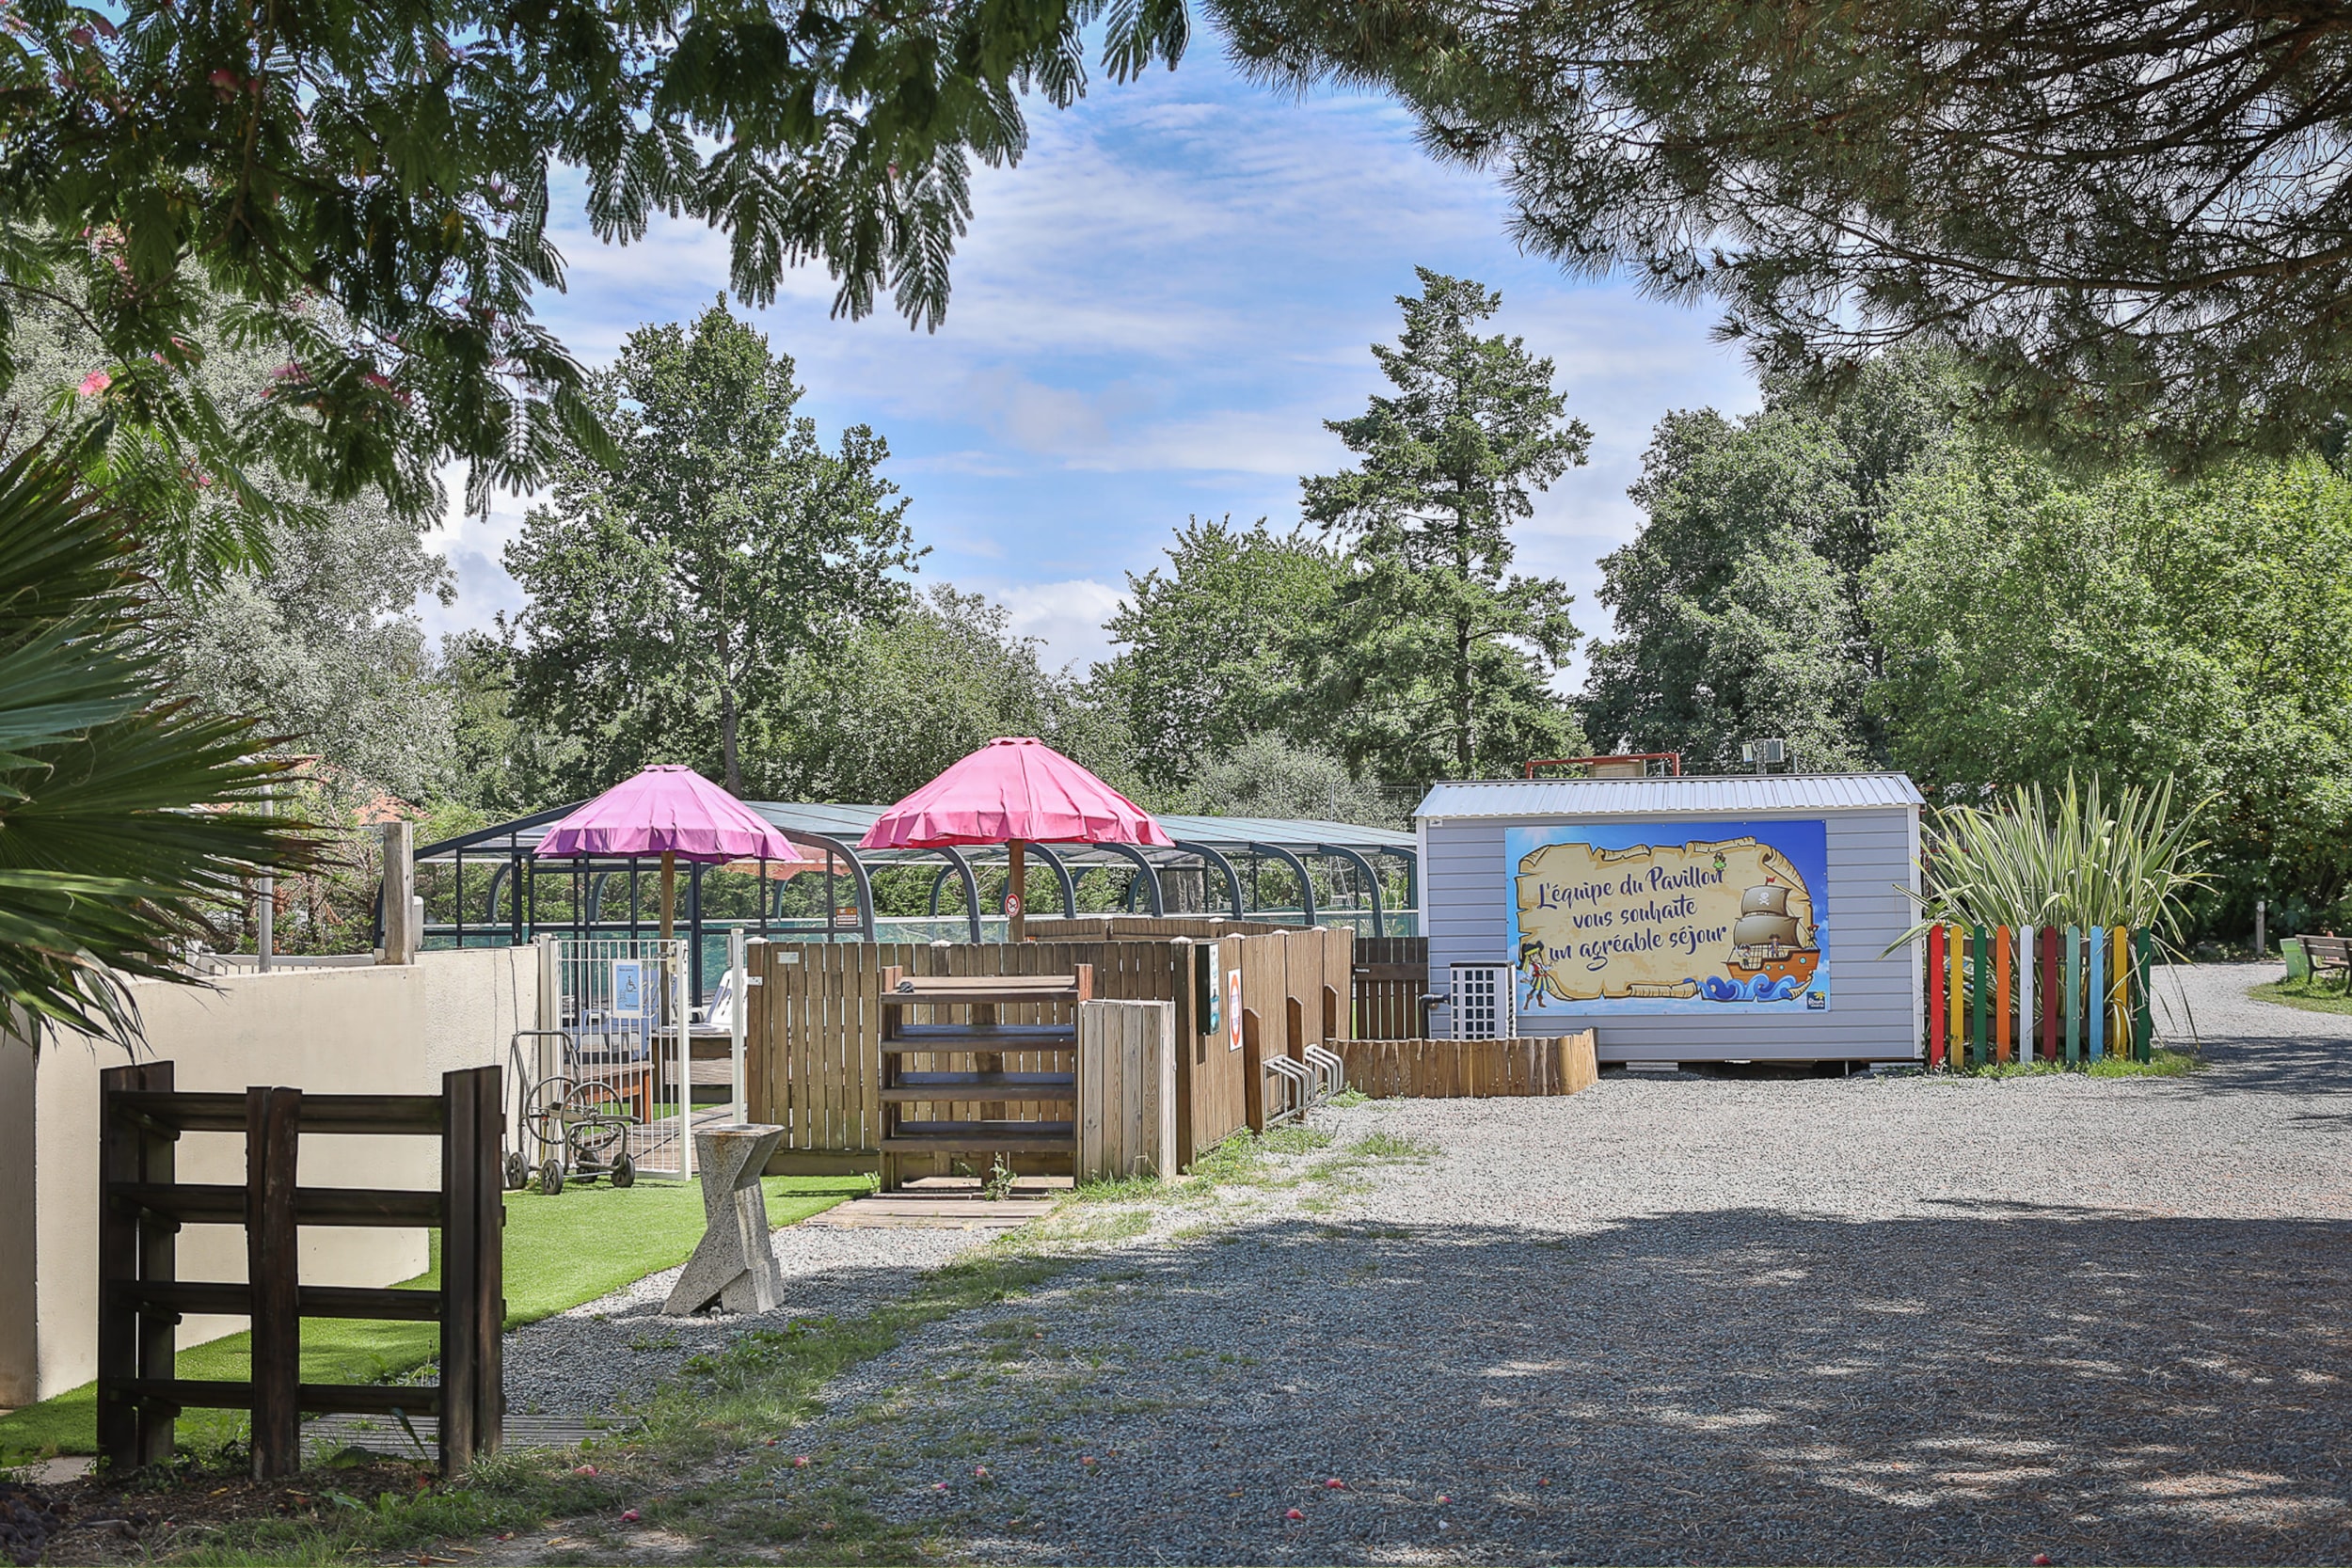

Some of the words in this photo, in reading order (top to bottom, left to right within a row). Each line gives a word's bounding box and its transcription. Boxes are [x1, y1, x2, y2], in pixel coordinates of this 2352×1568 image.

[1537, 881, 1614, 910] L'équipe
[1620, 873, 1644, 895] du
[1645, 865, 1724, 892] Pavillon
[1573, 911, 1613, 929] vous
[1620, 894, 1698, 924] souhaite
[1549, 944, 1572, 961] un
[1580, 928, 1663, 972] agréable
[1669, 925, 1727, 956] séjour
